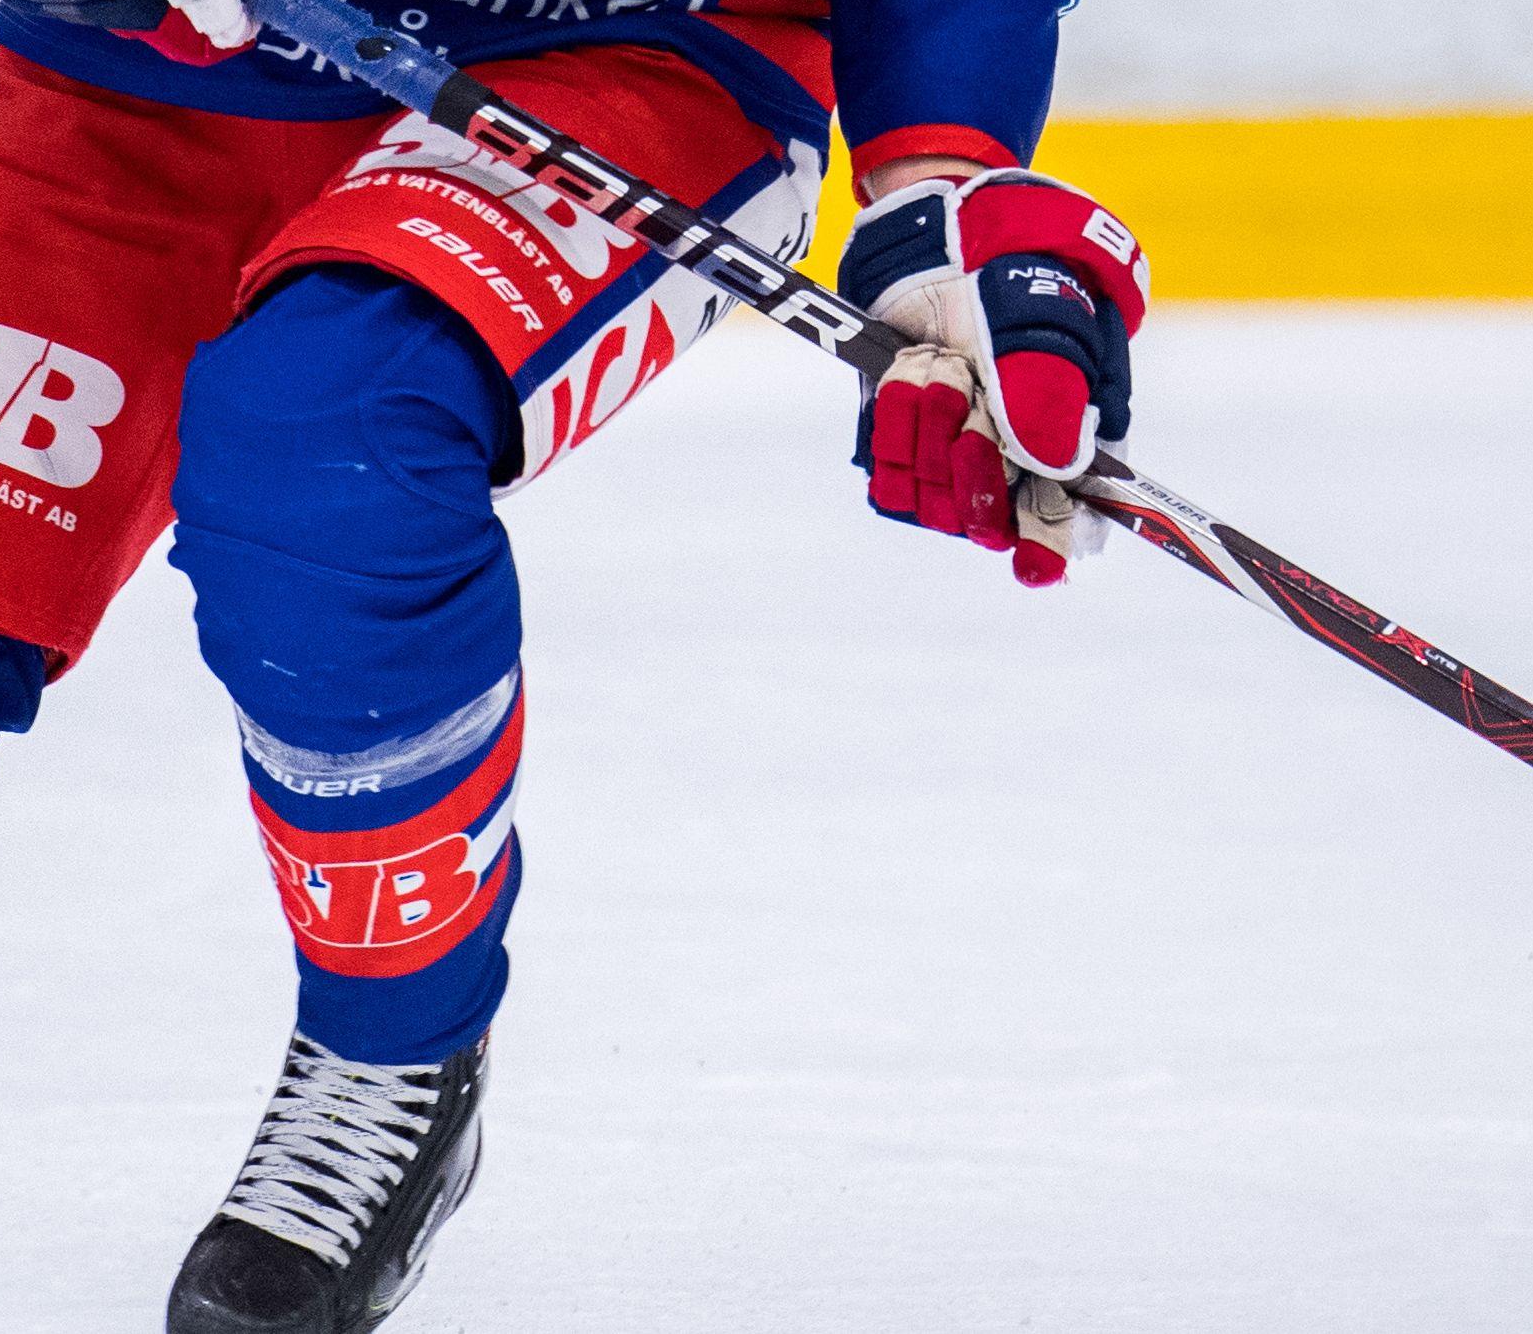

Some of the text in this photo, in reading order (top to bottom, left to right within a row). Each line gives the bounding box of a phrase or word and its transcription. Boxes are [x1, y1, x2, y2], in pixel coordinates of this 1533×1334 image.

[396, 216, 544, 333] BAUER
[545, 273, 574, 306] AB
[44, 504, 79, 533] AB
